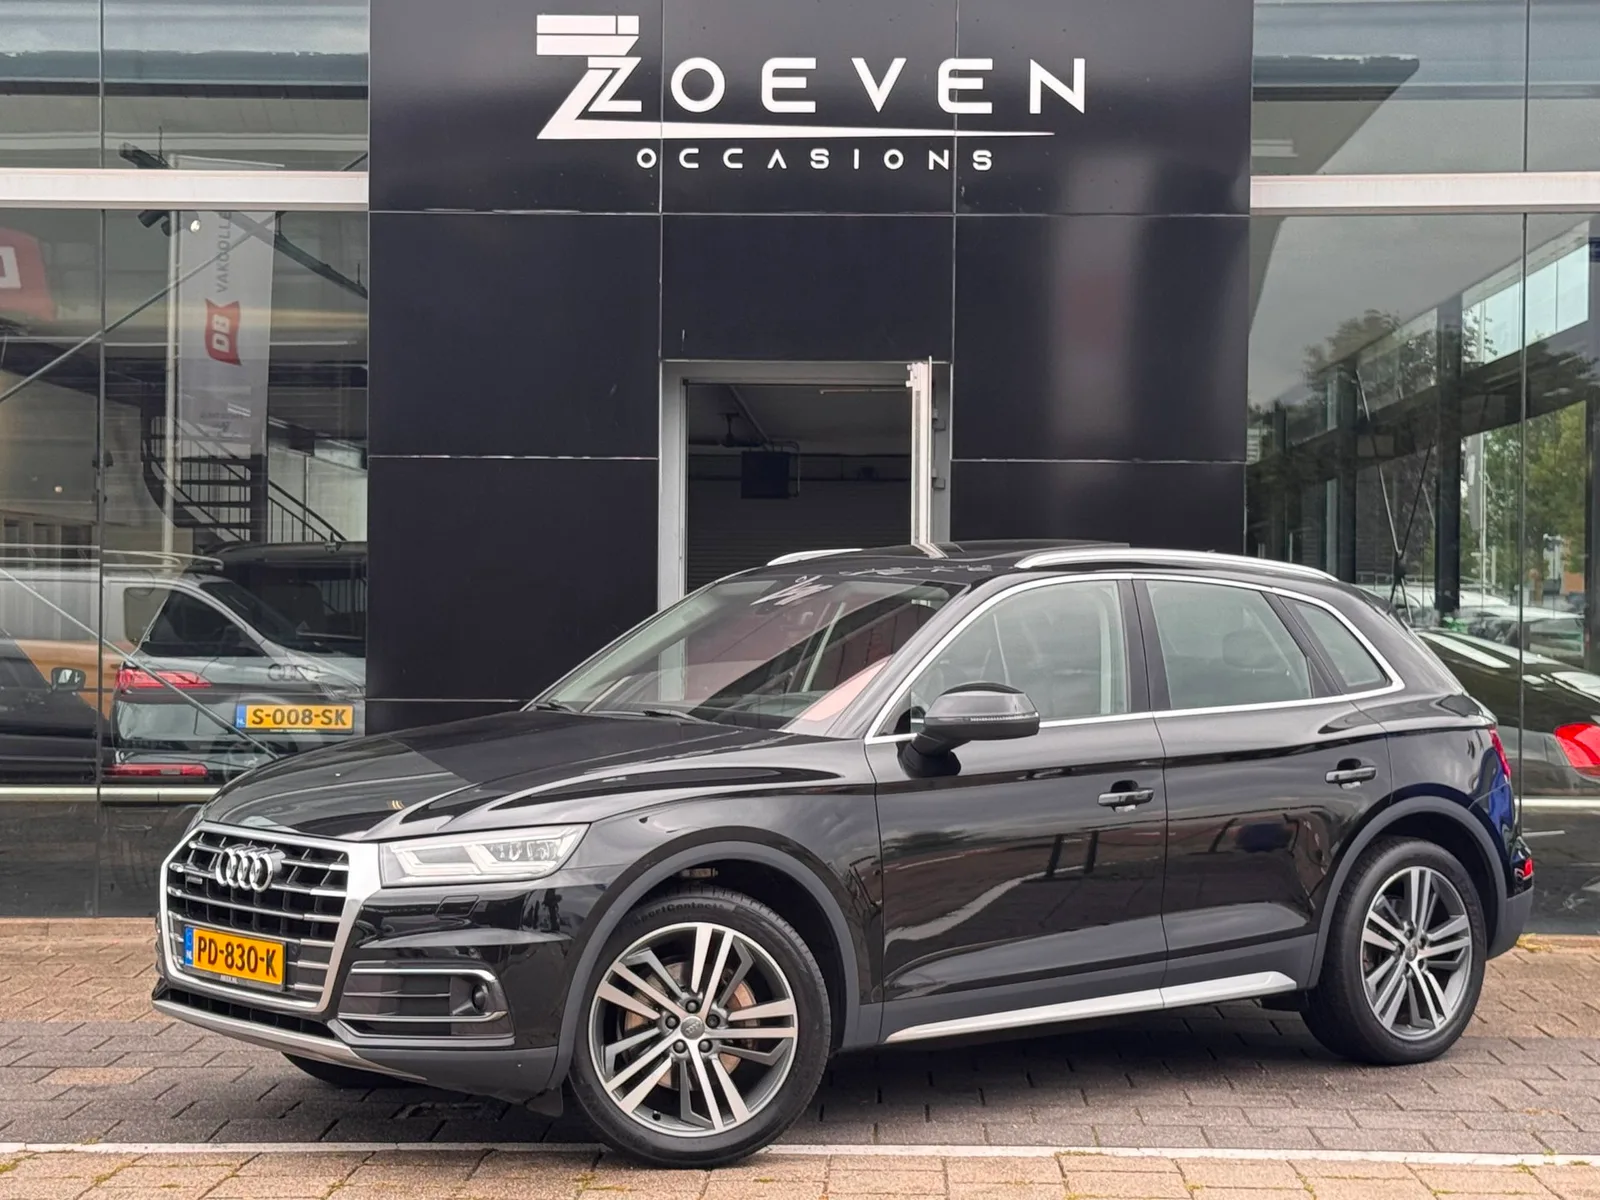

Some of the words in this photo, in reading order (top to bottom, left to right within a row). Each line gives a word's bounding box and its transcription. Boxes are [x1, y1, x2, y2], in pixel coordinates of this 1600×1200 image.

[536, 15, 1086, 139] ZOEVEN
[636, 148, 993, 171] OCCASIONS
[251, 708, 347, 726] S-008-SK
[197, 935, 278, 979] PD-830-K
